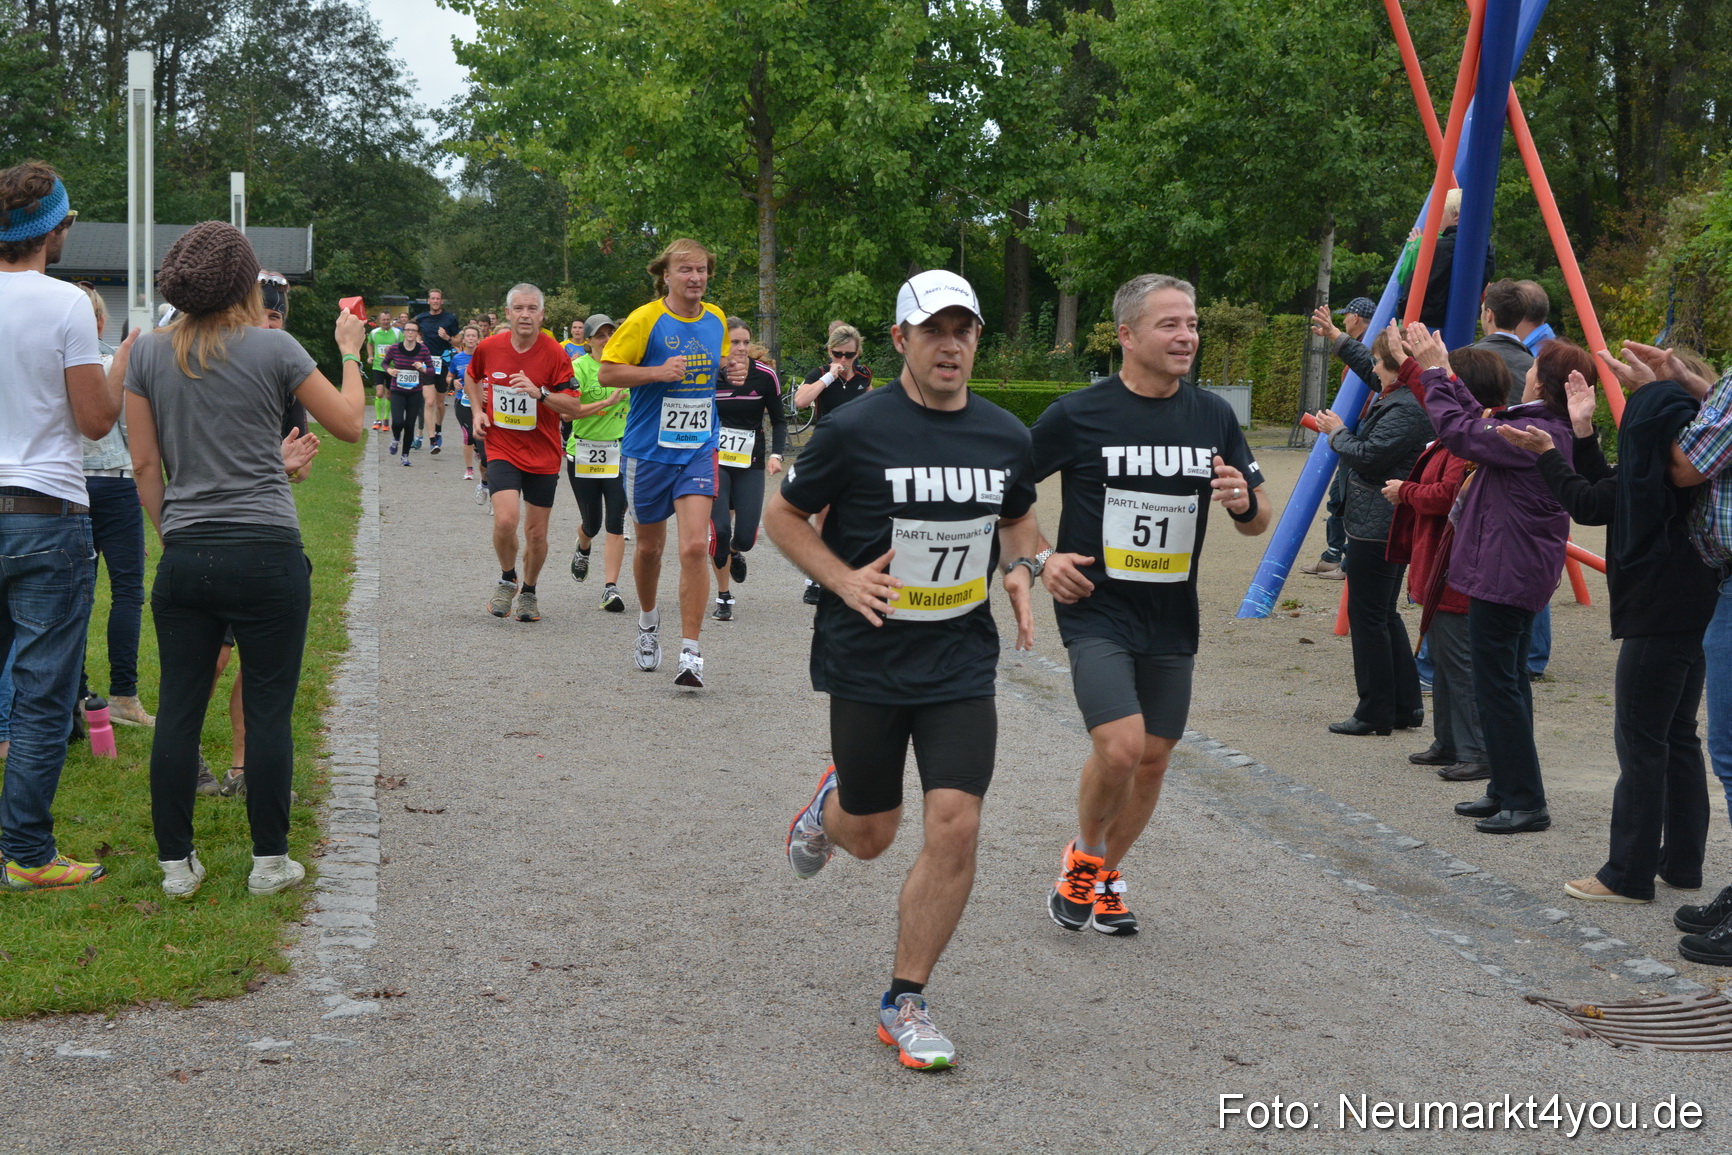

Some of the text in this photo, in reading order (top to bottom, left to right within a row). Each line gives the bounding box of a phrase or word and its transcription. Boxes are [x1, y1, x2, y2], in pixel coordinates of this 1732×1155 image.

[399, 374, 417, 383] 2900
[499, 396, 528, 414] 314
[504, 416, 521, 424] Claus
[666, 410, 707, 429] 2743
[675, 434, 698, 442] Achim
[719, 434, 747, 452] 217
[589, 449, 607, 463] 23
[1102, 446, 1212, 478] THULE
[1187, 468, 1210, 476] SWEDEN
[884, 466, 1006, 505] THULE
[1107, 497, 1186, 513] PARTL Neumarkt
[895, 528, 982, 541] PARTL Neumarkt
[1132, 515, 1169, 548] 51
[928, 545, 971, 582] 77
[1125, 554, 1170, 570] Oswald
[908, 587, 974, 606] Waldemar
